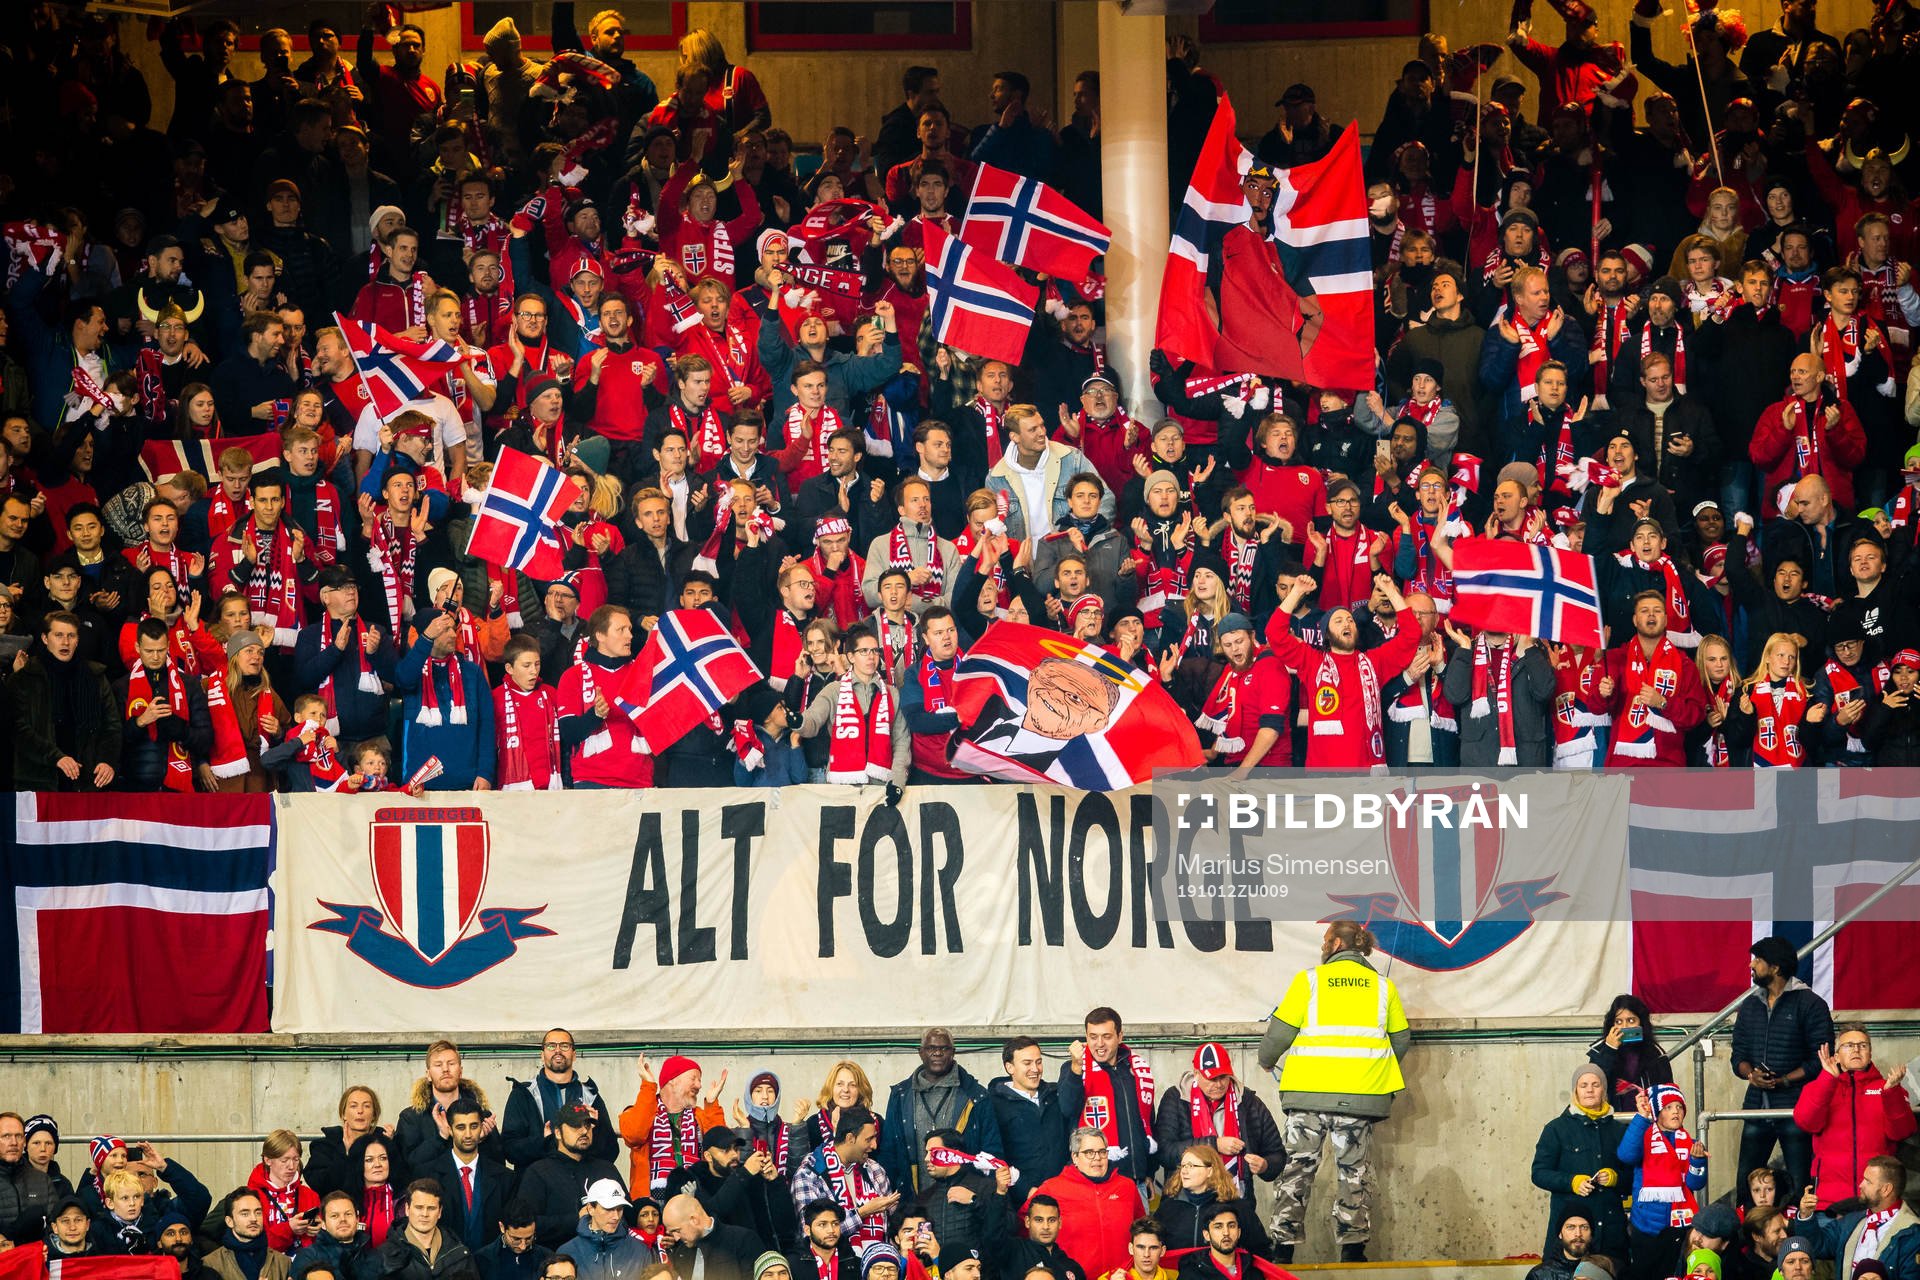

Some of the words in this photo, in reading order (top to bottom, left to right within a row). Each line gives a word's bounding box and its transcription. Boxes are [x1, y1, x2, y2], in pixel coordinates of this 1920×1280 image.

[612, 802, 765, 969] ALT
[817, 801, 964, 958] FOR
[1017, 790, 1273, 952] NORGE
[1327, 977, 1371, 988] SERVICE
